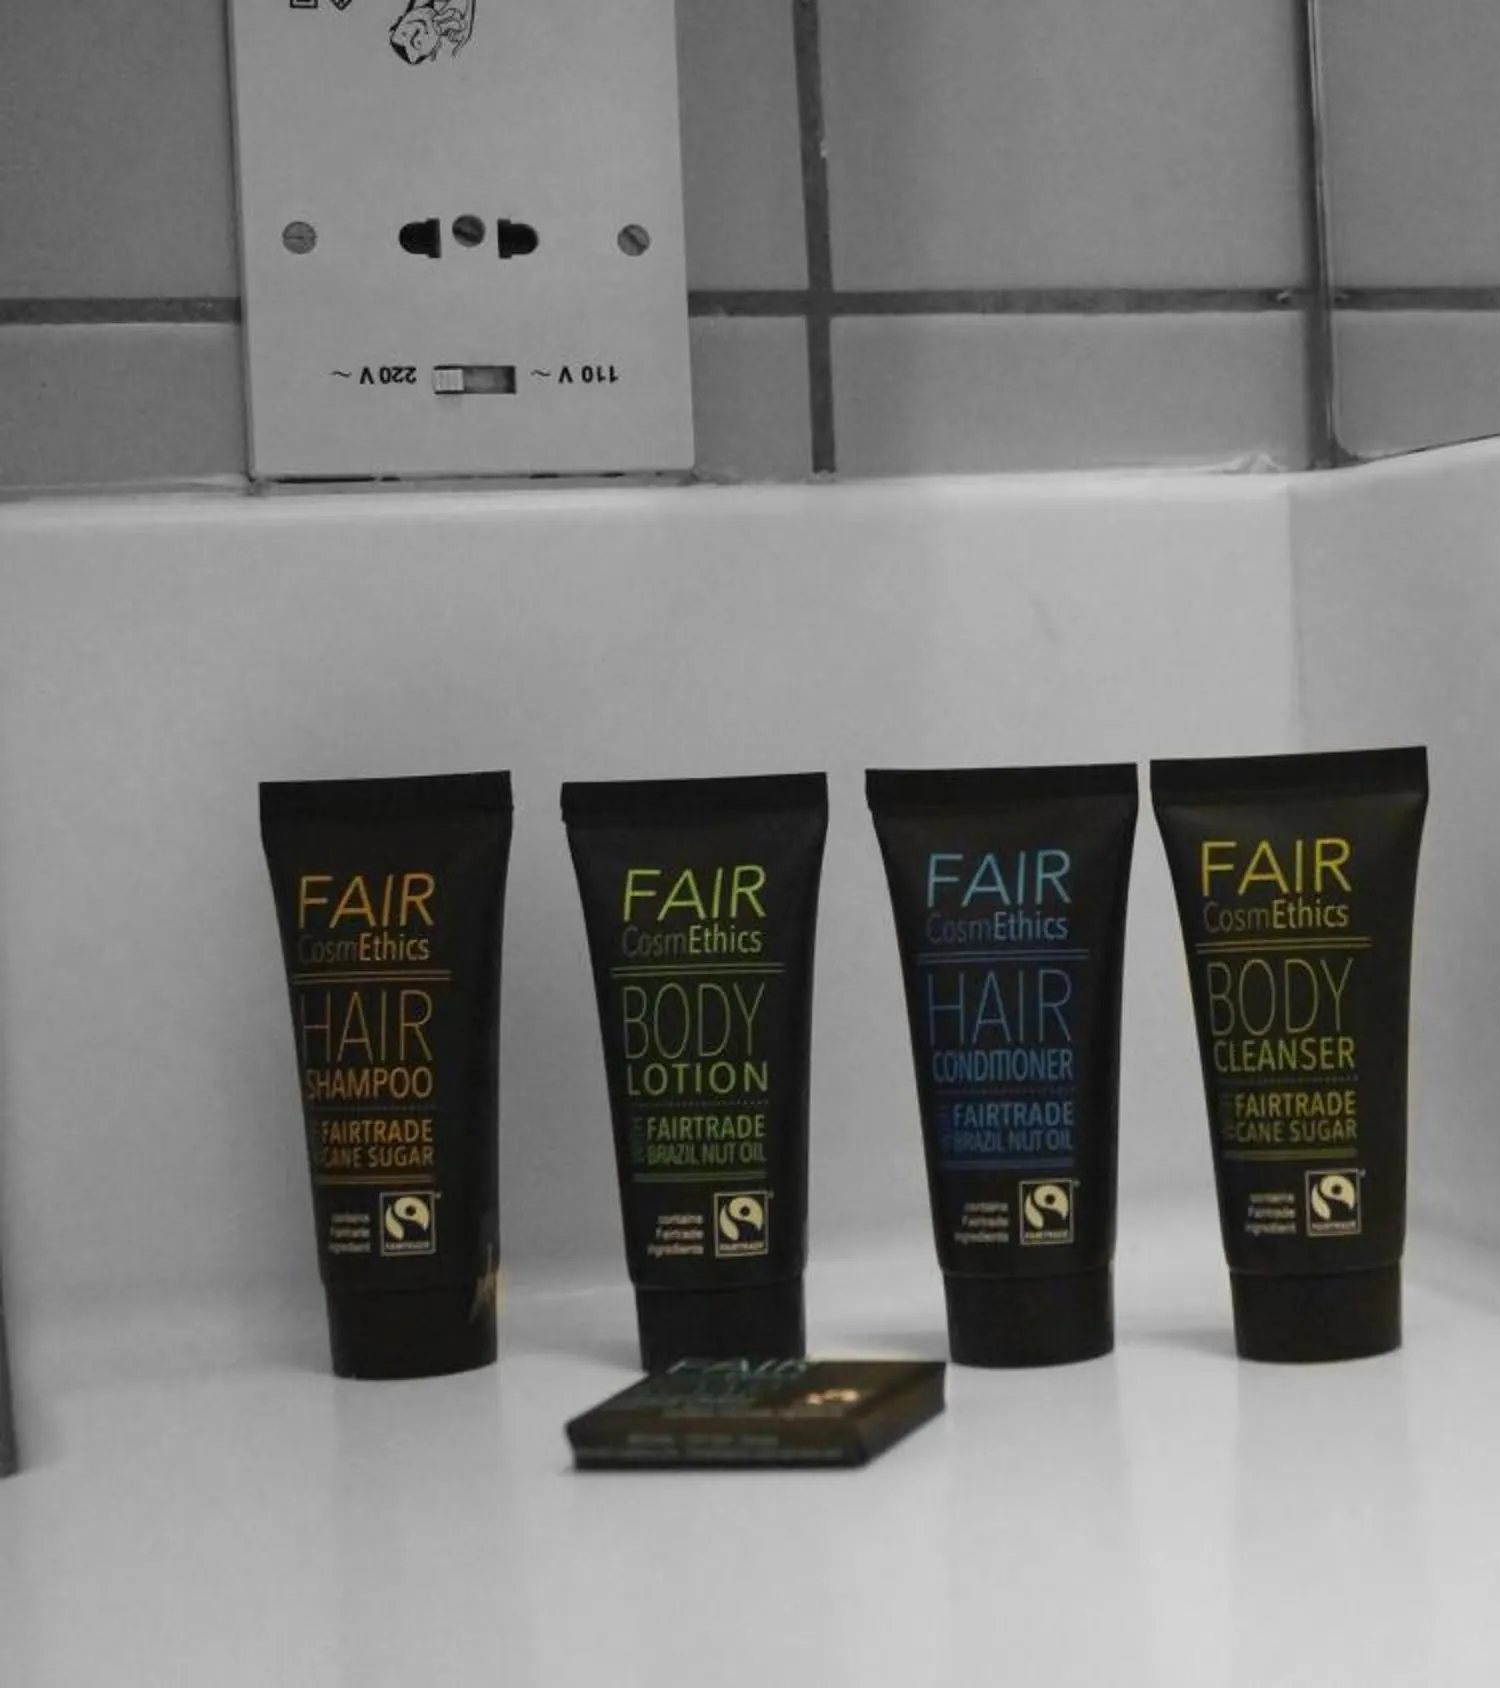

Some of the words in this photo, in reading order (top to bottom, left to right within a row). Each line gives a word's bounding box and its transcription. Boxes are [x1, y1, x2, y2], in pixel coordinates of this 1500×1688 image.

[581, 366, 620, 384] 110
[927, 849, 1072, 908] FAIR
[1201, 837, 1352, 897] FAIR
[299, 872, 436, 929] FAIR
[623, 864, 767, 922] FAIR
[926, 910, 1069, 944] CosmEthics
[1202, 897, 1349, 933] CosmEthics
[299, 931, 431, 964] CosmEthics
[622, 922, 764, 957] CosmEthics
[927, 968, 1073, 1046] HAIR
[1207, 957, 1355, 1037] BODY
[301, 989, 434, 1063] HAIR
[622, 981, 766, 1060] BODY
[932, 1049, 1073, 1083] CONDITIONER
[1213, 1036, 1356, 1073] CLEANSER
[305, 1066, 433, 1099] SHAMPOO
[627, 1061, 768, 1096] LOTION
[953, 1101, 1075, 1127] FAIRTRADE
[1234, 1089, 1357, 1118] FAIRTRADE
[321, 1118, 433, 1144] FAIRTRADE
[647, 1113, 767, 1141] FAIRTRADE
[953, 1130, 1007, 1152] BRAZIL
[1009, 1129, 1043, 1152] NUT
[1046, 1128, 1074, 1151] OIL
[1235, 1120, 1284, 1143] CANE
[1289, 1119, 1358, 1142] SUGAR
[323, 1146, 363, 1168] CANE
[368, 1145, 434, 1168] SUGAR
[647, 1143, 699, 1165] BRAZIL
[702, 1142, 736, 1164] NUT
[739, 1141, 768, 1163] OIL
